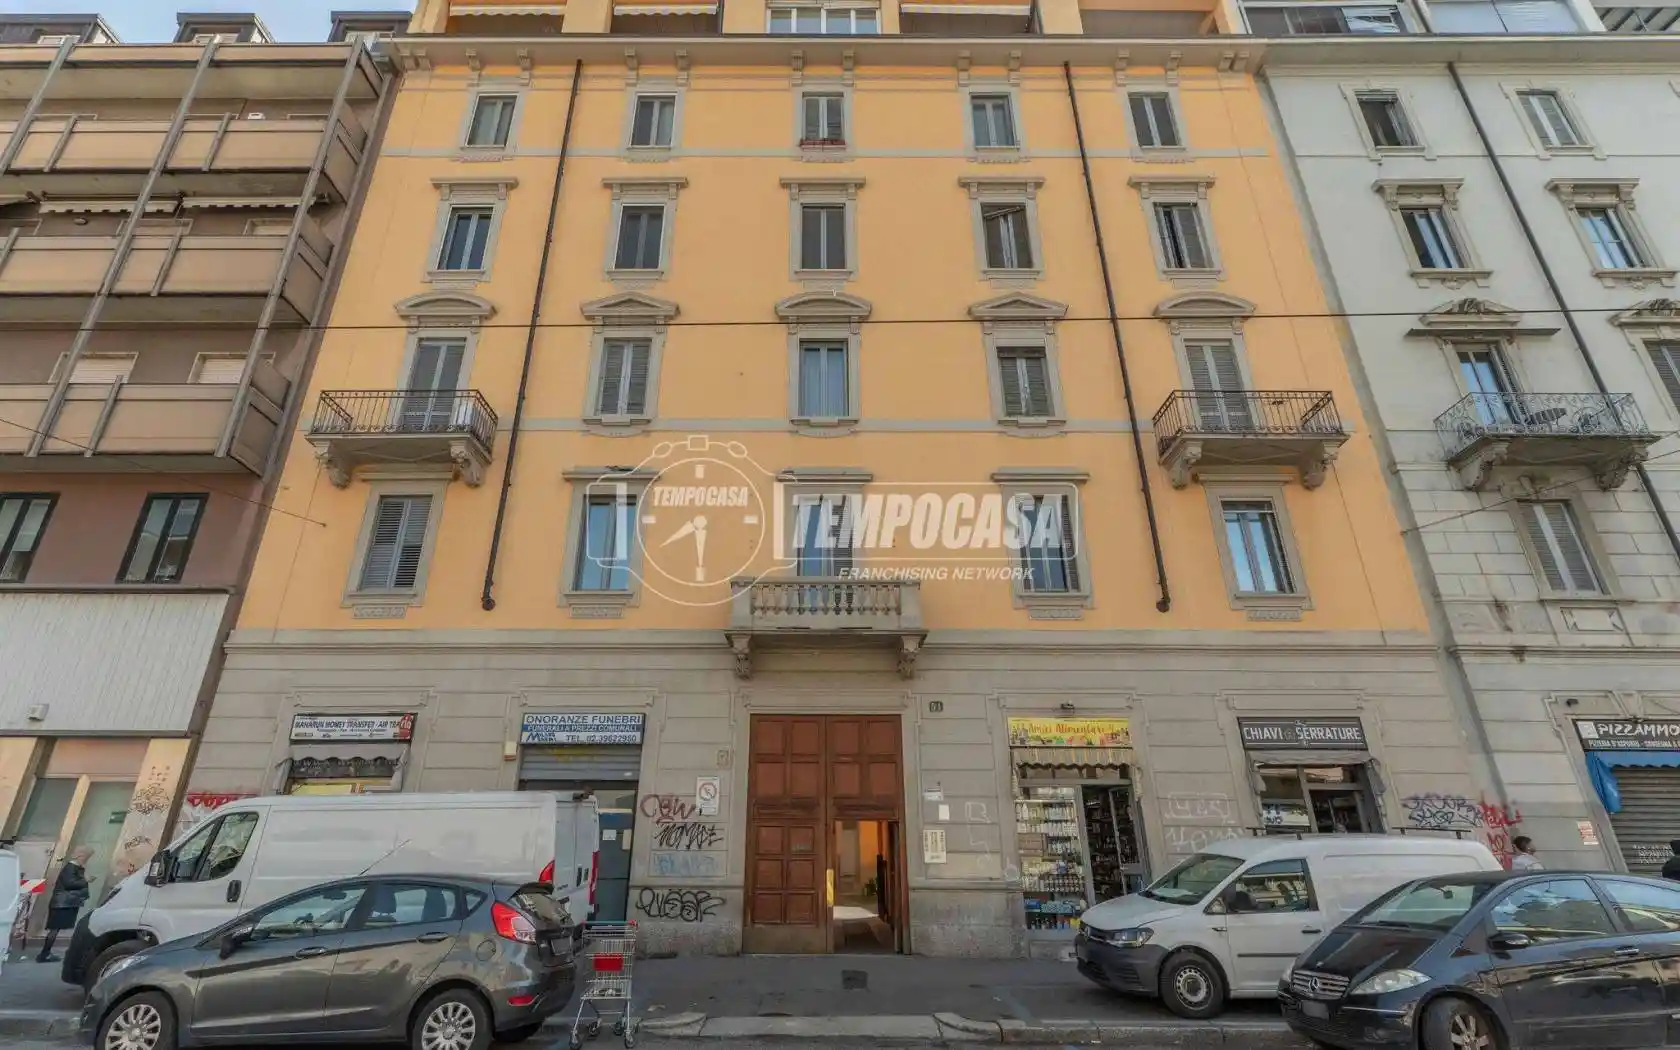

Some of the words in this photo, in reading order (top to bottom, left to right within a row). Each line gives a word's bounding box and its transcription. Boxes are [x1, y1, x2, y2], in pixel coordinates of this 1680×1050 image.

[325, 720, 346, 728] MONEY
[346, 720, 376, 728] TRANSFER
[526, 715, 589, 724] ONORANZE
[591, 715, 641, 724] FUNEBRI
[1243, 727, 1283, 741] CHIAVI
[1295, 727, 1362, 741] SERRATURE
